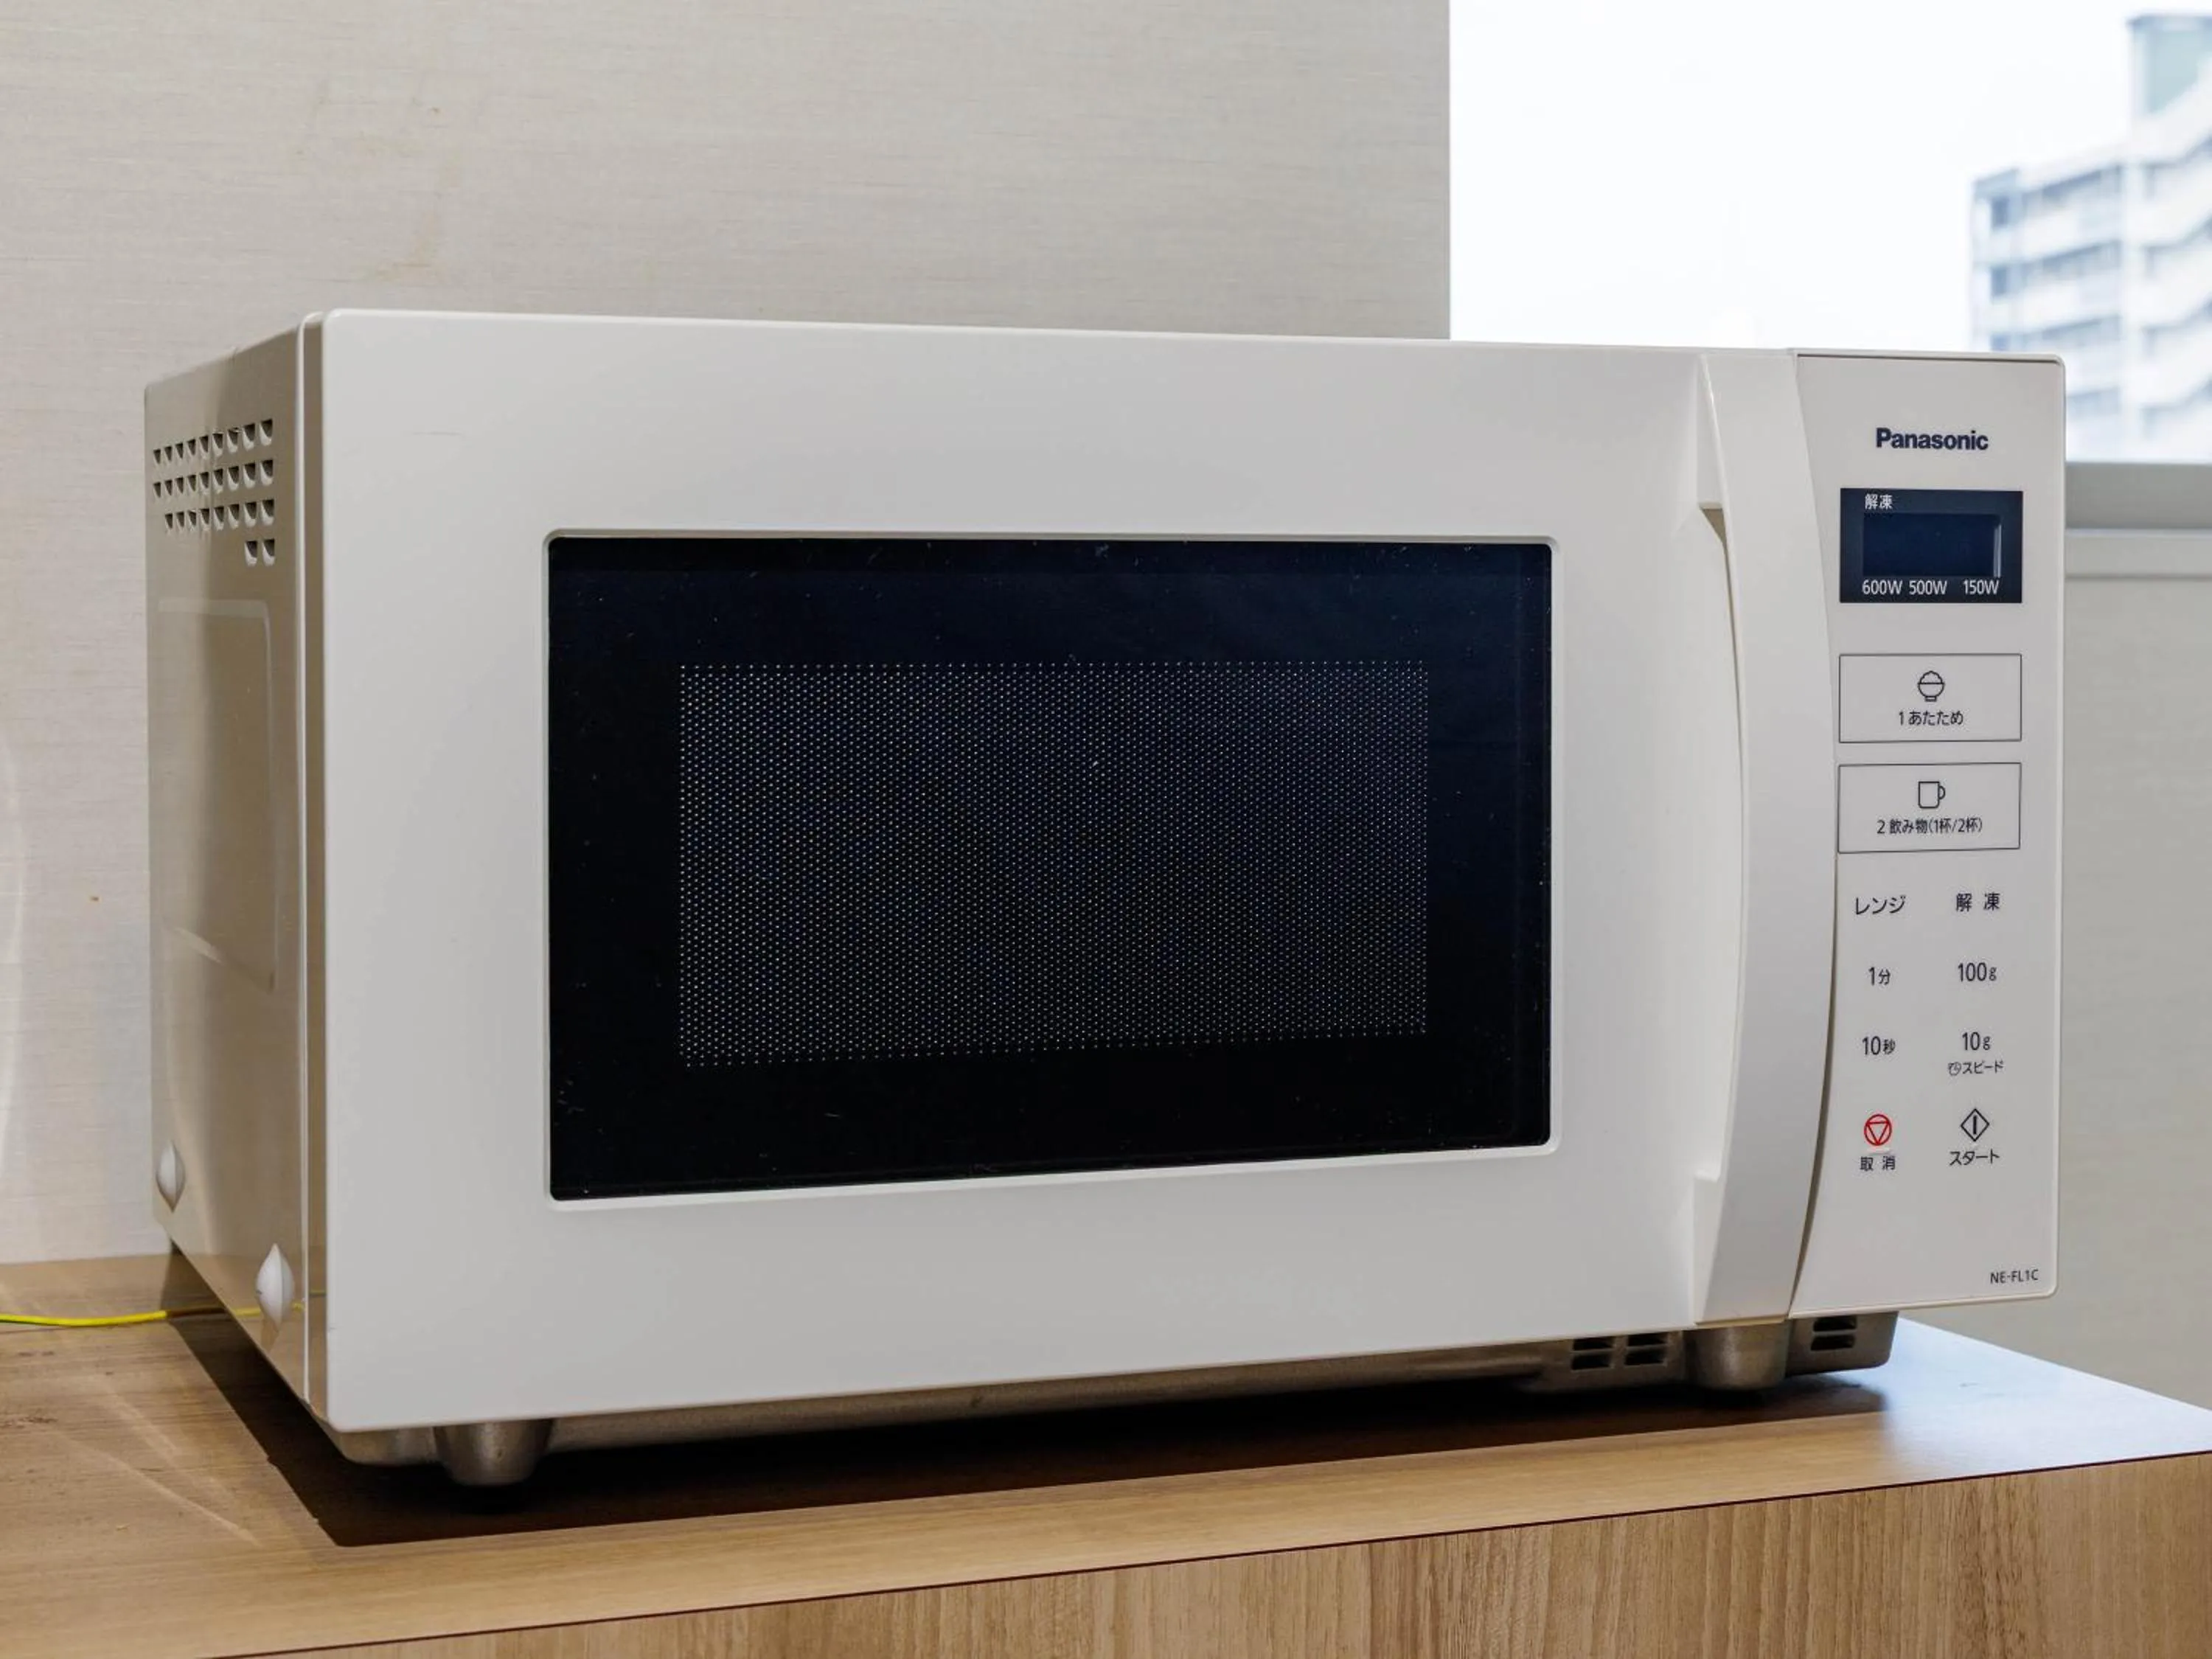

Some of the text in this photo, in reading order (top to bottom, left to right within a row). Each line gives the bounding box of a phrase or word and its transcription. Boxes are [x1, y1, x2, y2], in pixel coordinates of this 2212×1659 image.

[1875, 428, 1989, 450] Panasonic
[1865, 493, 1893, 509] 解凍
[1862, 580, 2000, 595] 600W 500W 150W
[1855, 895, 1906, 915] レンジ
[1868, 967, 1891, 986] 1分
[1958, 962, 1997, 981] 100g
[1862, 1036, 1896, 1055] 10秒
[1962, 1032, 1991, 1051] 10g
[1962, 1060, 2003, 1074] スピード
[1950, 1149, 2000, 1166] スタート
[1990, 1269, 2039, 1284] NE-FL1C
